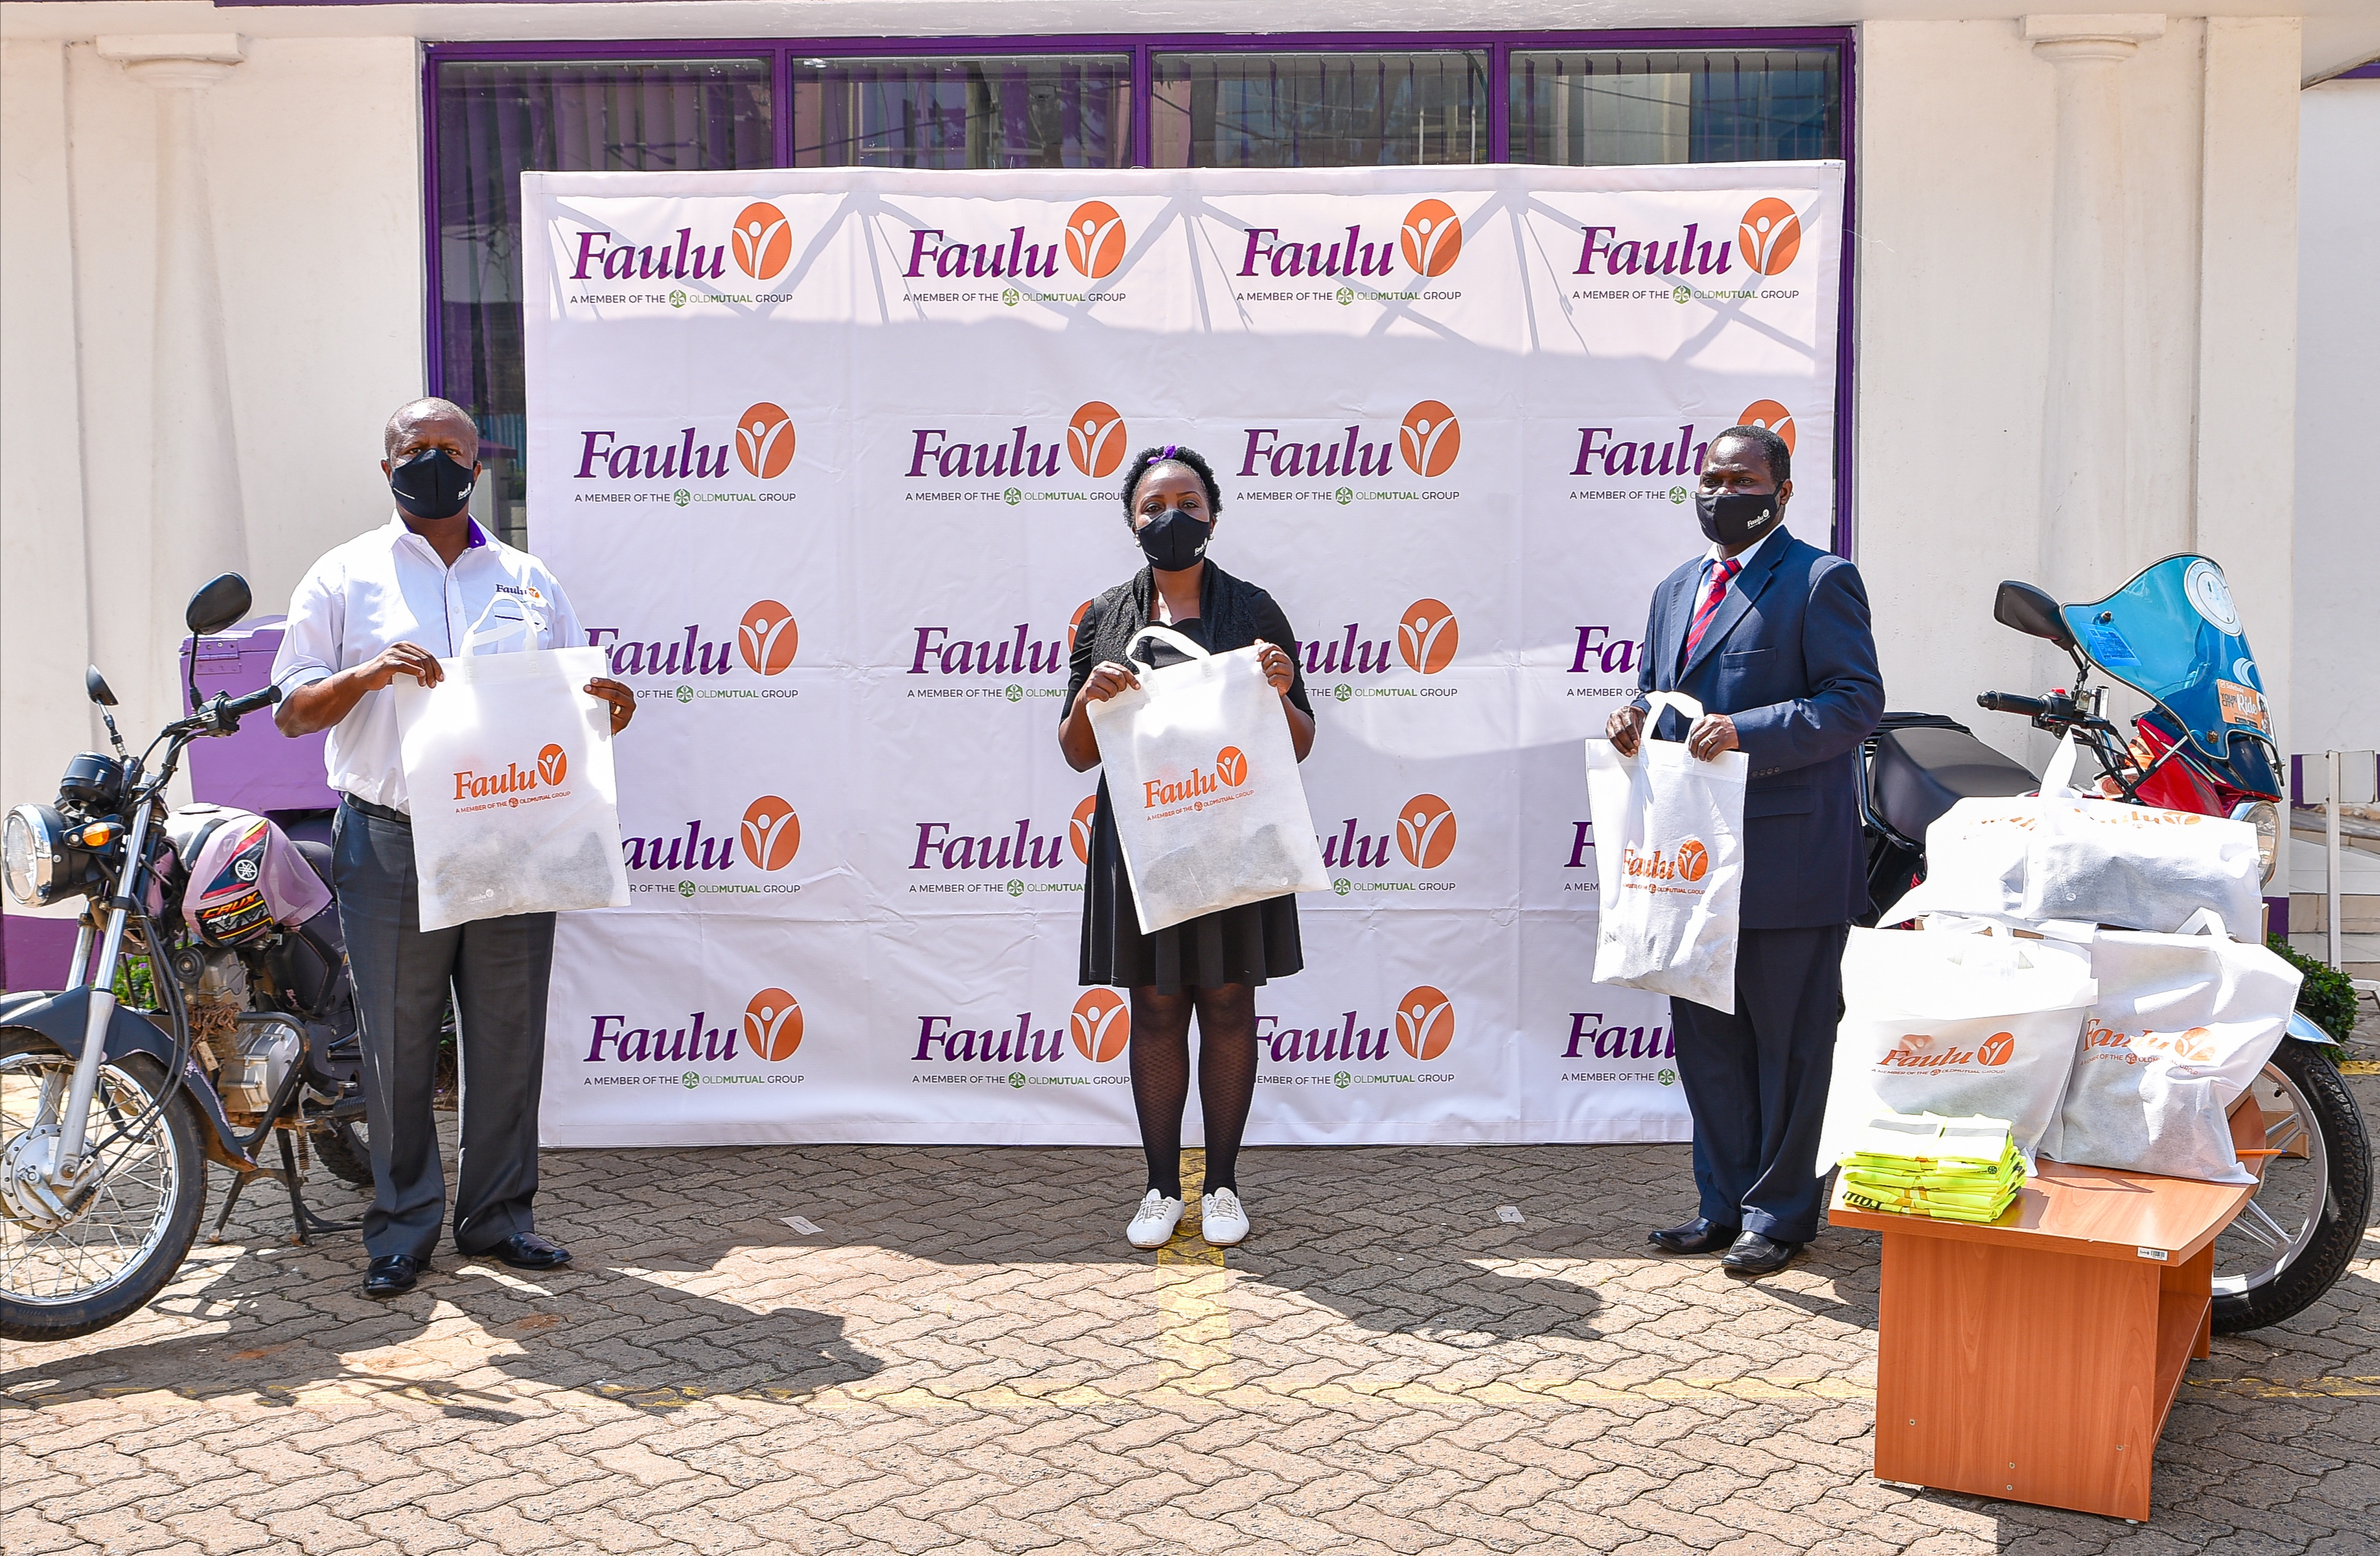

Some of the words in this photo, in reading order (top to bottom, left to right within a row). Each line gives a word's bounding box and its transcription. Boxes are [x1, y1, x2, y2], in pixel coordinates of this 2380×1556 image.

[570, 228, 725, 279] Faulu
[902, 226, 1058, 277] Faulu
[1237, 225, 1393, 277] Faulu
[1573, 223, 1731, 275] Faulu
[574, 427, 729, 478] Faulu
[905, 426, 1060, 477] Faulu
[1237, 425, 1392, 477] Faulu
[1570, 424, 1710, 475] Faul
[907, 623, 1061, 674] Faulu
[1296, 623, 1391, 673] ulu
[2237, 694, 2258, 715] Ride
[453, 762, 537, 800] Faulu
[461, 804, 486, 813] MEMBER
[520, 794, 551, 804] OLDMUTUAL
[1143, 768, 1218, 808] Faulu
[1152, 811, 1175, 820] MEMBER
[1203, 796, 1235, 807] OLDMUTUAL
[1235, 790, 1254, 799] GROUP
[619, 820, 734, 870] aulu
[908, 819, 1062, 869] Faulu
[1316, 818, 1389, 868] ulu
[1622, 849, 1675, 880] Faulu
[202, 892, 258, 918] CRUX
[583, 1012, 738, 1062] Faulu
[912, 1012, 1064, 1062] Faulu
[1876, 1046, 1973, 1067] Faulu
[1257, 1076, 1292, 1084] EMBER
